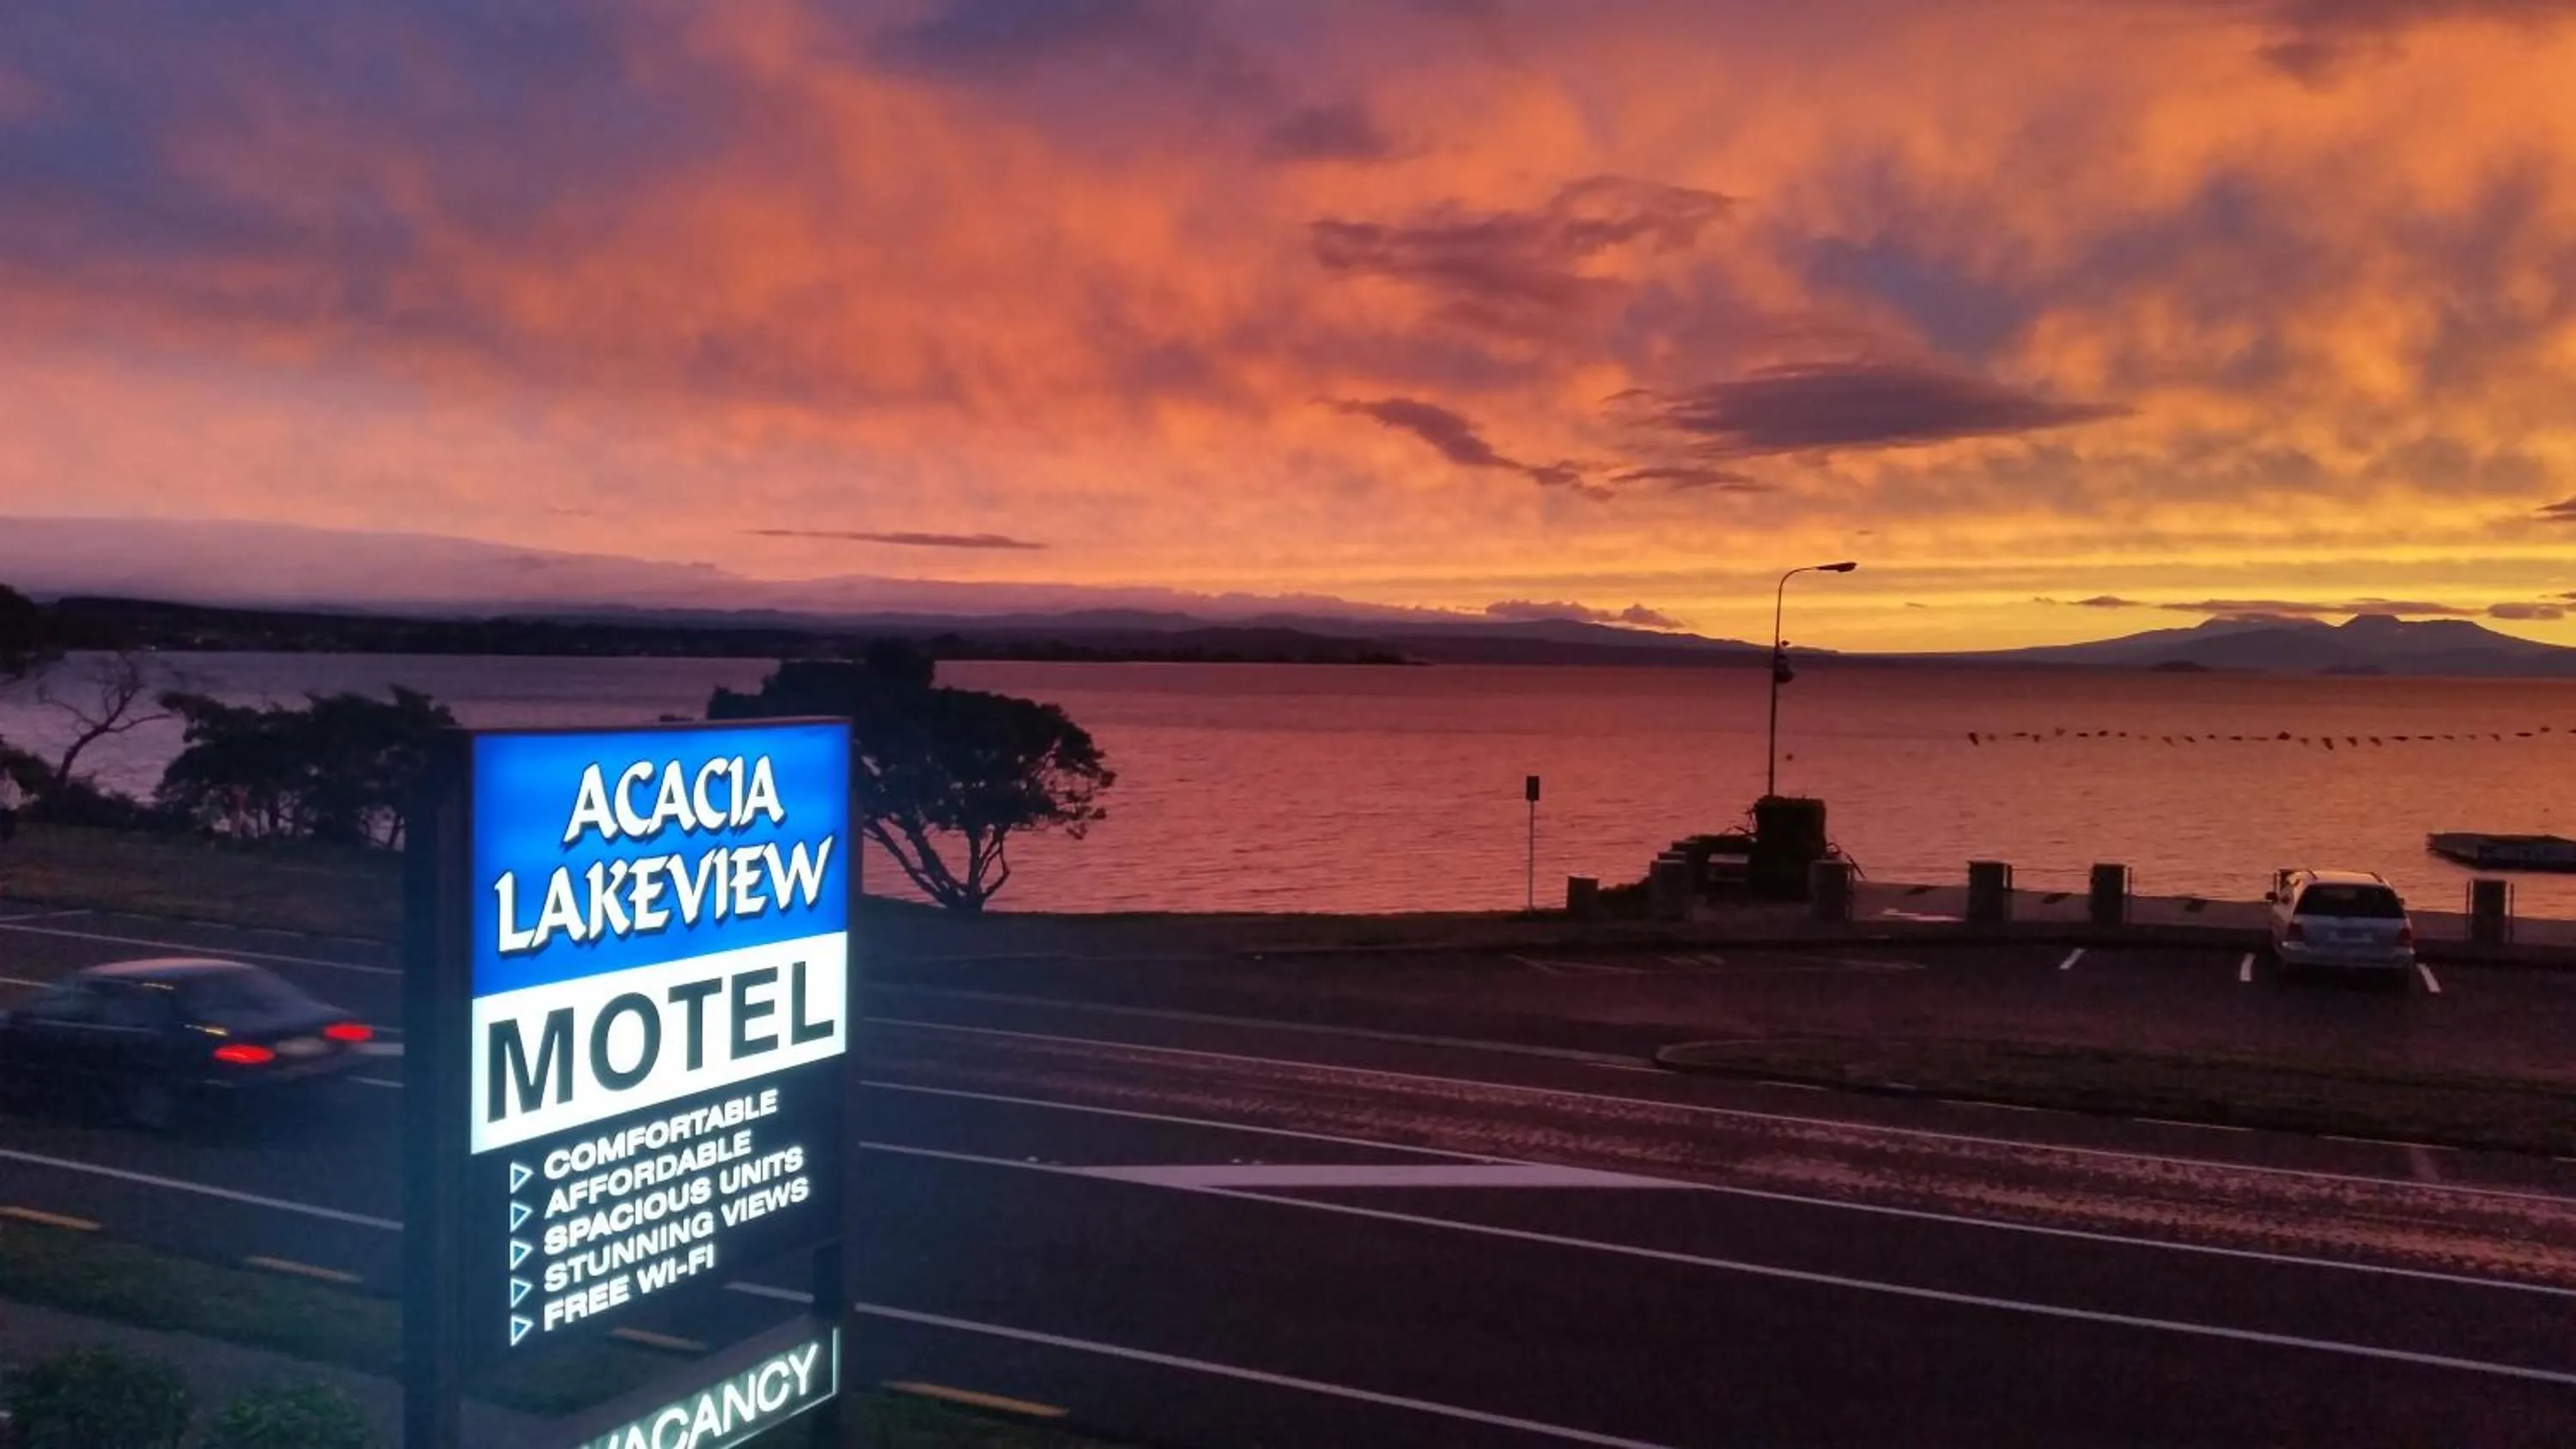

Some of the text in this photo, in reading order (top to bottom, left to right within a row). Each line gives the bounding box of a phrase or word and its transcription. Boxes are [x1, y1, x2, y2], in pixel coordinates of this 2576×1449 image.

[562, 755, 786, 845] ACACIA
[494, 835, 835, 955] LAKEVIEW
[487, 961, 835, 1125] MOTEL
[544, 1089, 779, 1180] COMFORTABLE
[544, 1130, 752, 1220] AFFORDABLE
[544, 1146, 805, 1257] SPACIOUS UNITS
[544, 1177, 811, 1294] STUNNING VIEWS
[544, 1244, 715, 1332] FREE WI-FI
[582, 1343, 818, 1449] ACANCY
